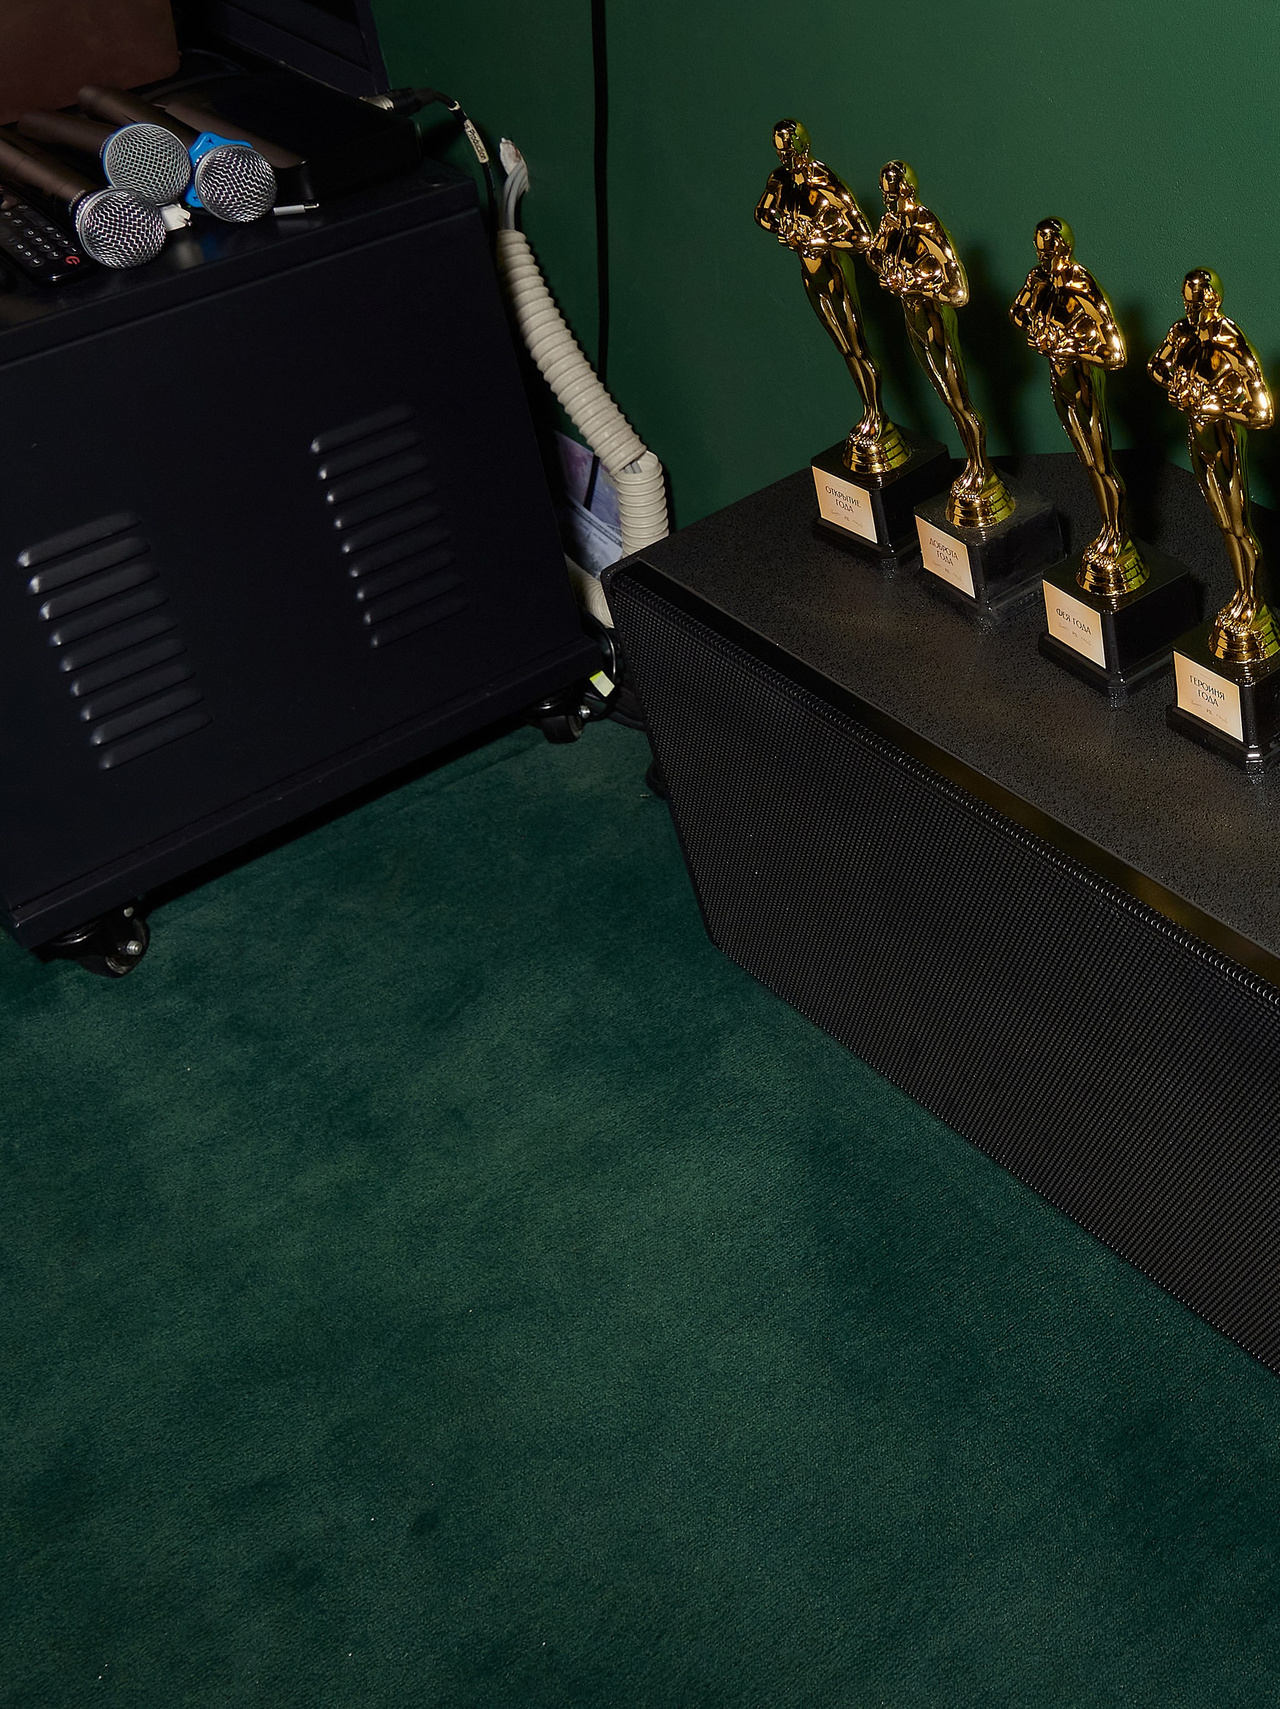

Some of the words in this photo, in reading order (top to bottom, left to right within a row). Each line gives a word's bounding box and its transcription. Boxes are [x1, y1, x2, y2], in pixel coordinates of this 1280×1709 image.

[825, 486, 861, 508] ОТКРЫТИЕ
[836, 499, 854, 513] ГОДА
[937, 551, 954, 566] ГОДА
[1056, 608, 1071, 622] ФЕЯ
[1073, 618, 1092, 635] ГОДА
[1190, 675, 1225, 701] ГЕРОИНЯ
[1198, 690, 1219, 707] ГОДА
